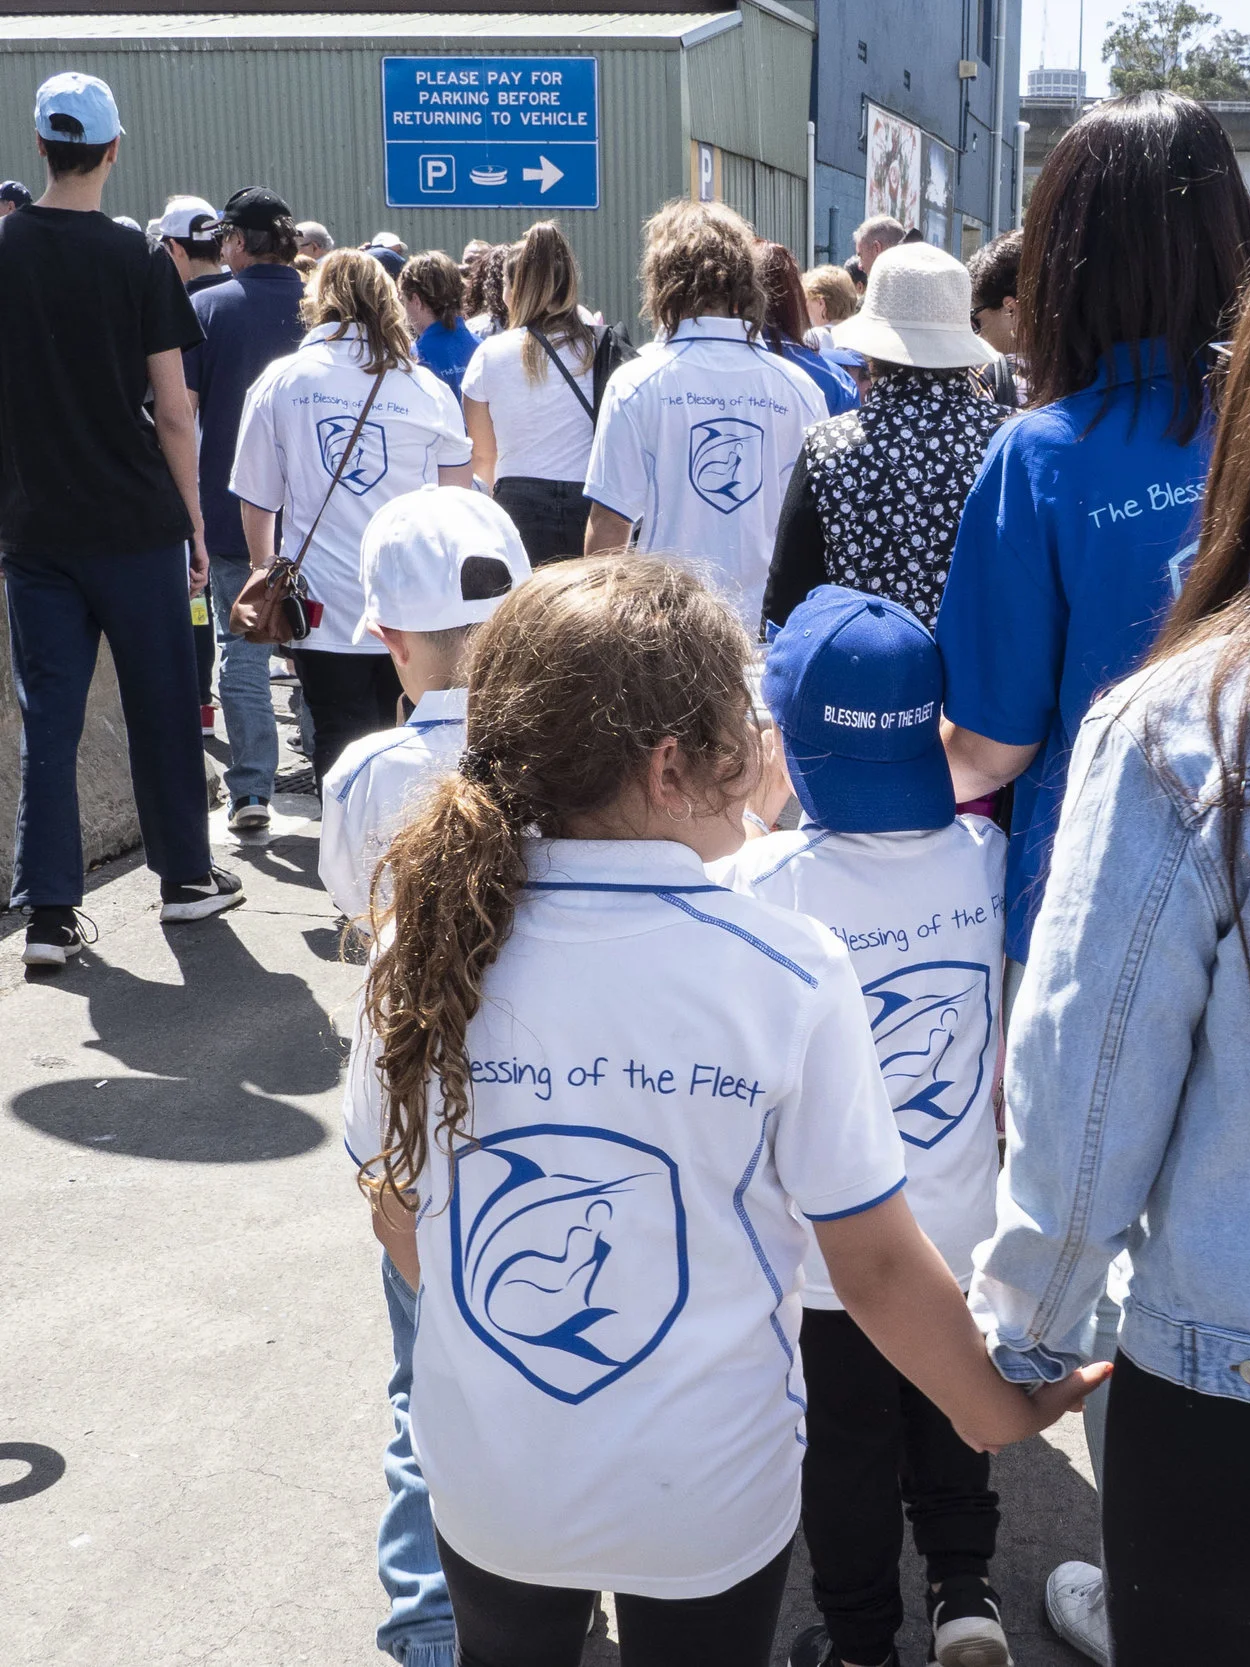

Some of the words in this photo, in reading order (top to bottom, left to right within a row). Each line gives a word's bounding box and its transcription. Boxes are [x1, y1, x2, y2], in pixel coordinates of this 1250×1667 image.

[416, 71, 479, 85] PLEASE
[488, 71, 522, 85] PAY
[531, 71, 563, 85] FOR
[419, 91, 489, 105] PARKING
[498, 91, 560, 105] BEFORE
[393, 111, 482, 125] RETURNING
[491, 111, 511, 125] TO
[520, 111, 588, 126] VEHICLE
[427, 160, 447, 187] P
[701, 147, 712, 200] P
[292, 396, 310, 407] The
[313, 392, 349, 409] Blessing
[352, 400, 364, 409] of
[371, 402, 383, 411] he
[387, 401, 410, 416] Fleet
[660, 396, 684, 406] The
[686, 392, 726, 411] Blessing
[730, 396, 744, 407] of
[749, 397, 766, 408] the
[1088, 499, 1143, 529] The
[1147, 481, 1207, 511] Bless
[824, 704, 876, 729] BLESSING
[880, 712, 897, 729] OF
[898, 708, 914, 729] THE
[917, 913, 942, 938] of
[951, 906, 988, 929] the
[470, 1056, 552, 1101] essing
[568, 1057, 608, 1087] of
[623, 1059, 677, 1094] the
[690, 1063, 766, 1107] Fleet
